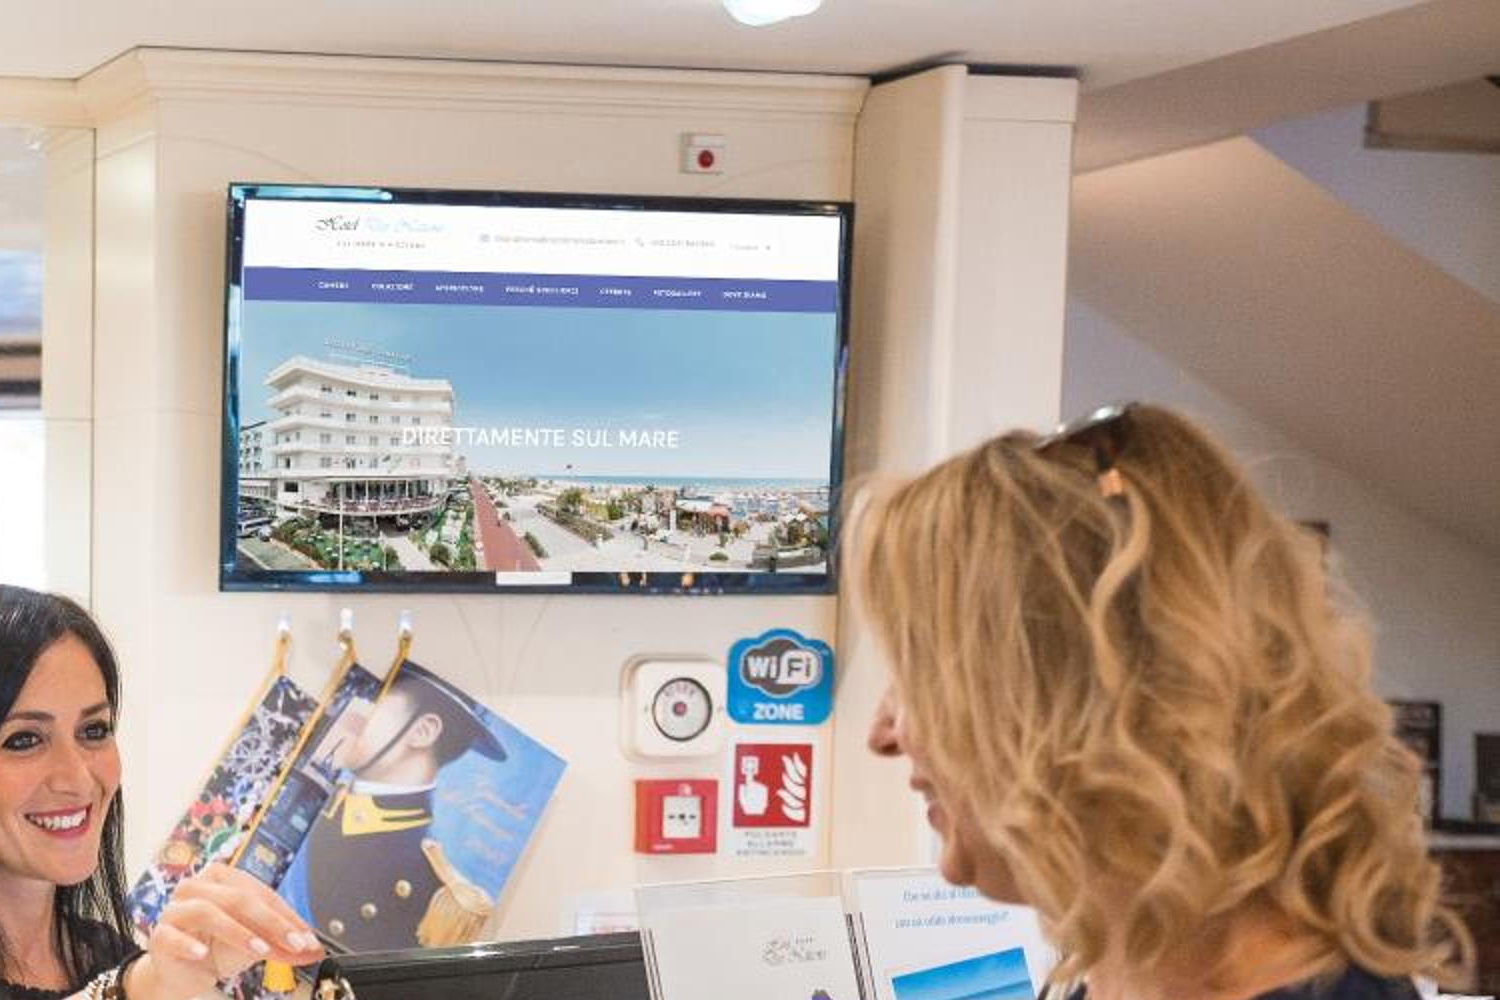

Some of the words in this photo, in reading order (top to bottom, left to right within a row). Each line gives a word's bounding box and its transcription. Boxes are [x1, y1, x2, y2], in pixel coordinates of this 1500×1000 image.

[402, 426, 565, 448] DIRETTAMENTE
[571, 428, 613, 448] SUL
[618, 429, 679, 449] MARE
[753, 702, 804, 721] ZONE
